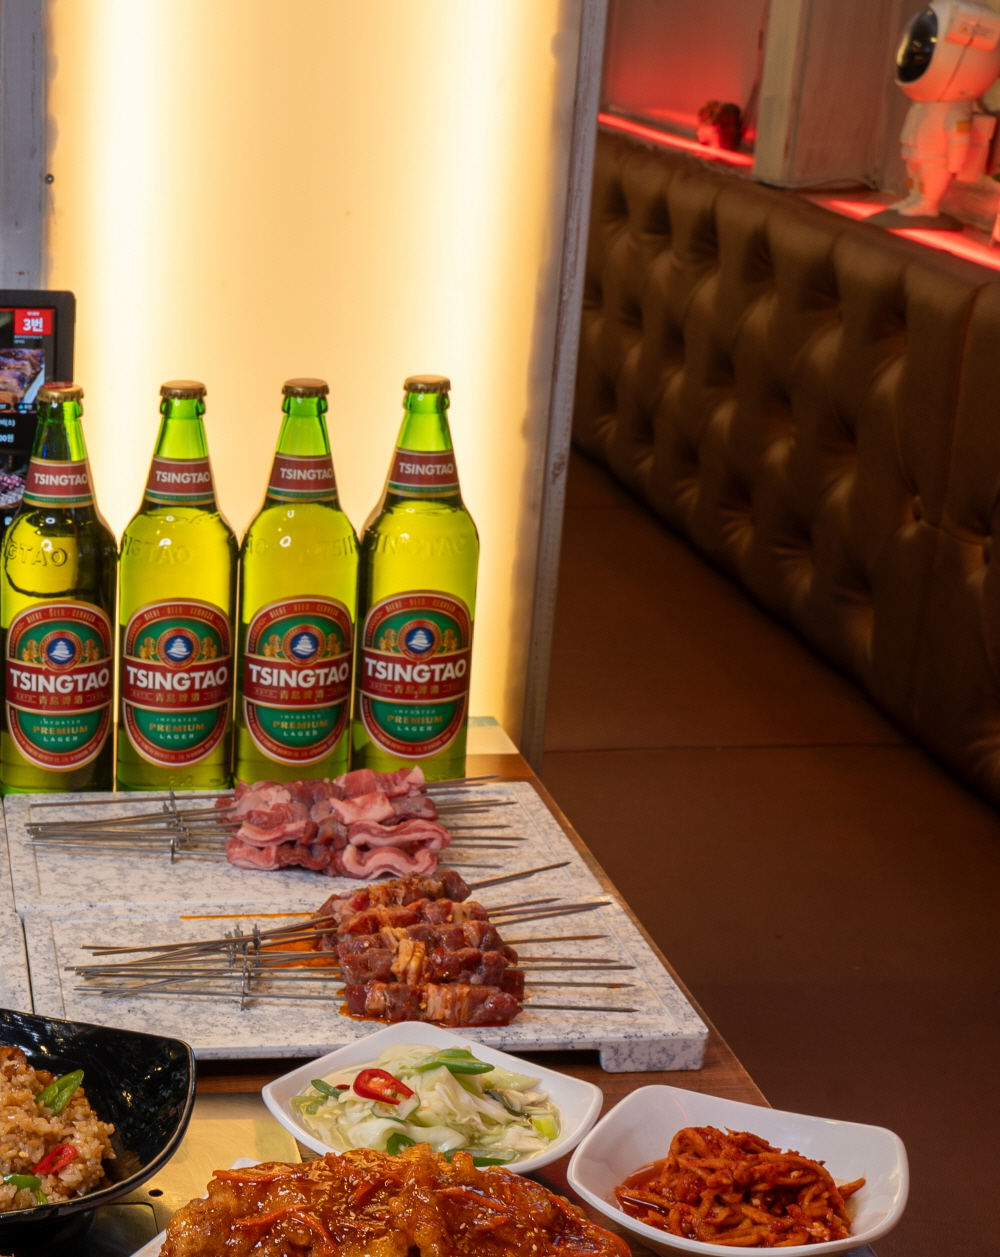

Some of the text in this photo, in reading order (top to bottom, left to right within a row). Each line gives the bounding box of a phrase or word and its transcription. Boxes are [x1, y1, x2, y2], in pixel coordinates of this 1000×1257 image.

[23, 317, 43, 332] 3번
[280, 467, 334, 480] TSINGTAO
[399, 462, 454, 475] TSINGTAO
[34, 473, 88, 486] TSINGTAO
[155, 470, 210, 484] TSINGTAO
[248, 662, 349, 688] TSINGTAO
[365, 657, 467, 683] TSINGTAO
[10, 668, 110, 694] TSINGTAO
[126, 665, 228, 691] TSINGTAO
[273, 719, 328, 729] PREMIUM
[386, 714, 443, 724] PREMIUM
[33, 725, 88, 735] PREMIUM
[149, 723, 204, 732] PREMIUM
